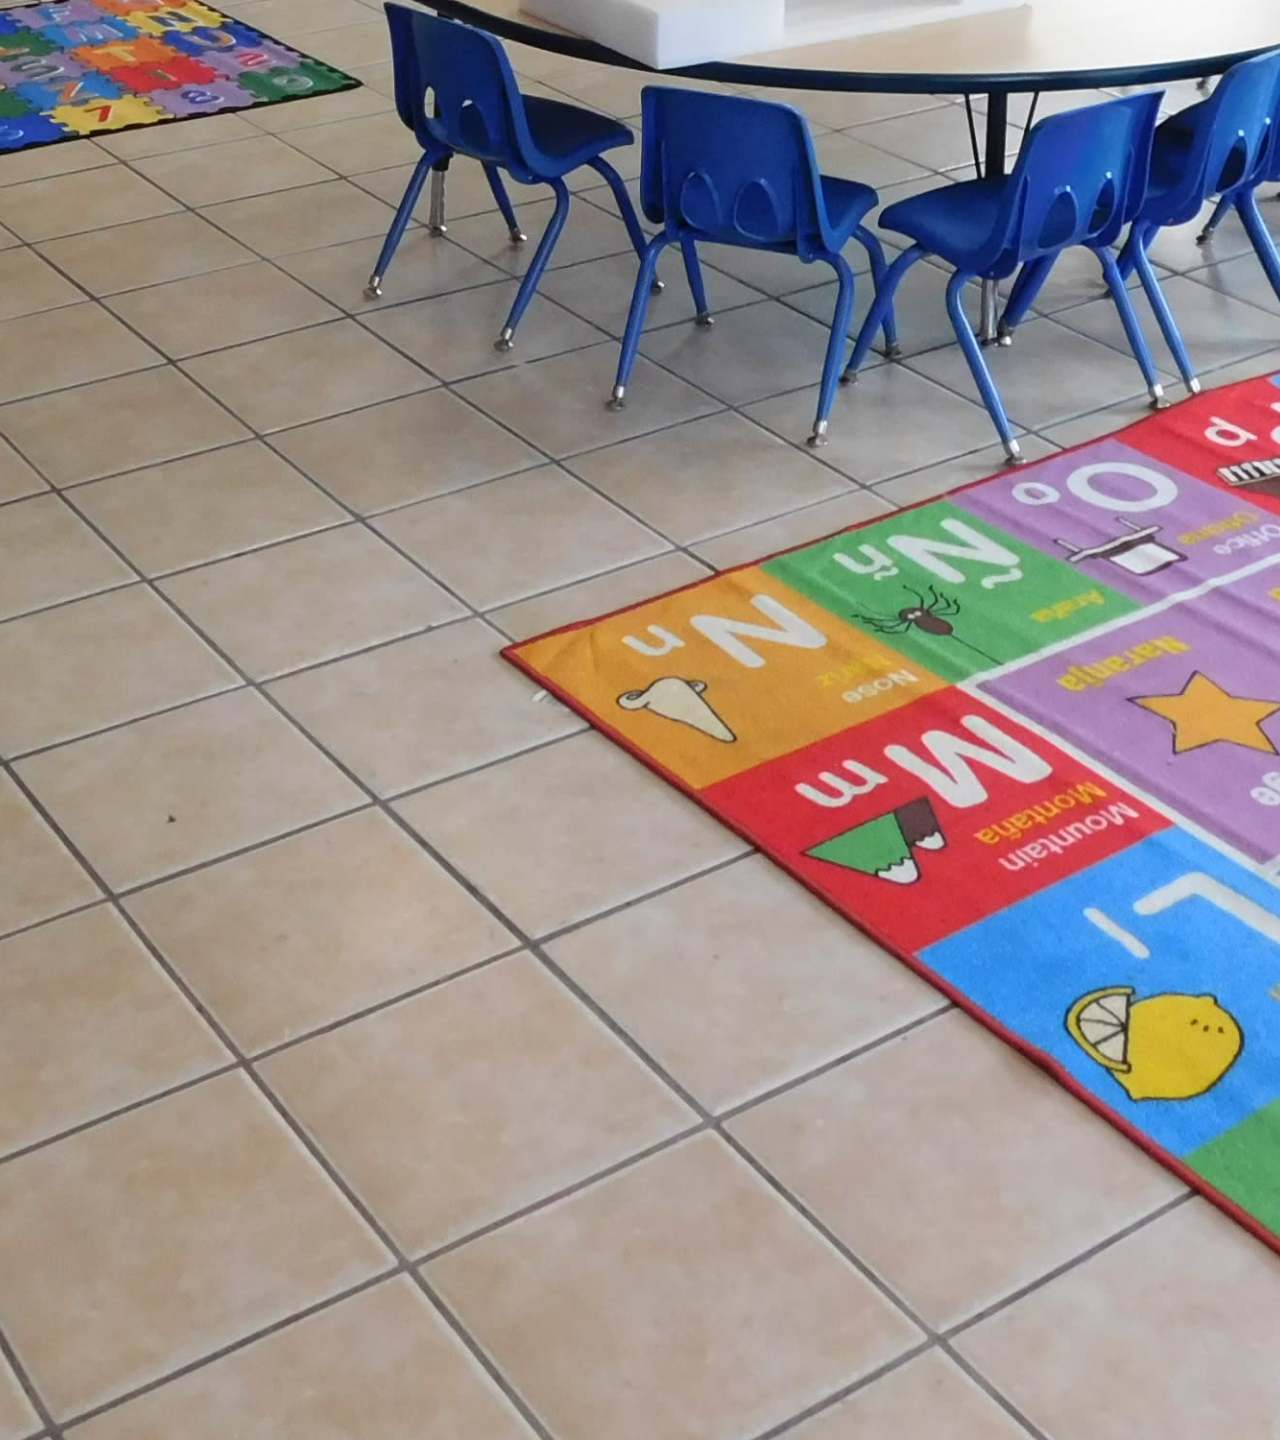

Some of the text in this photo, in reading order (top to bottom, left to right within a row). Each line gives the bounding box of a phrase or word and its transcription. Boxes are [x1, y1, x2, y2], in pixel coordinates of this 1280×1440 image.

[84, 105, 112, 123] 7
[1010, 461, 1179, 512] Oo
[622, 594, 828, 670] Nn
[840, 667, 919, 706] Nose
[794, 713, 1053, 809] Mm
[973, 778, 1108, 849] Montaña
[997, 799, 1140, 876] Mountain
